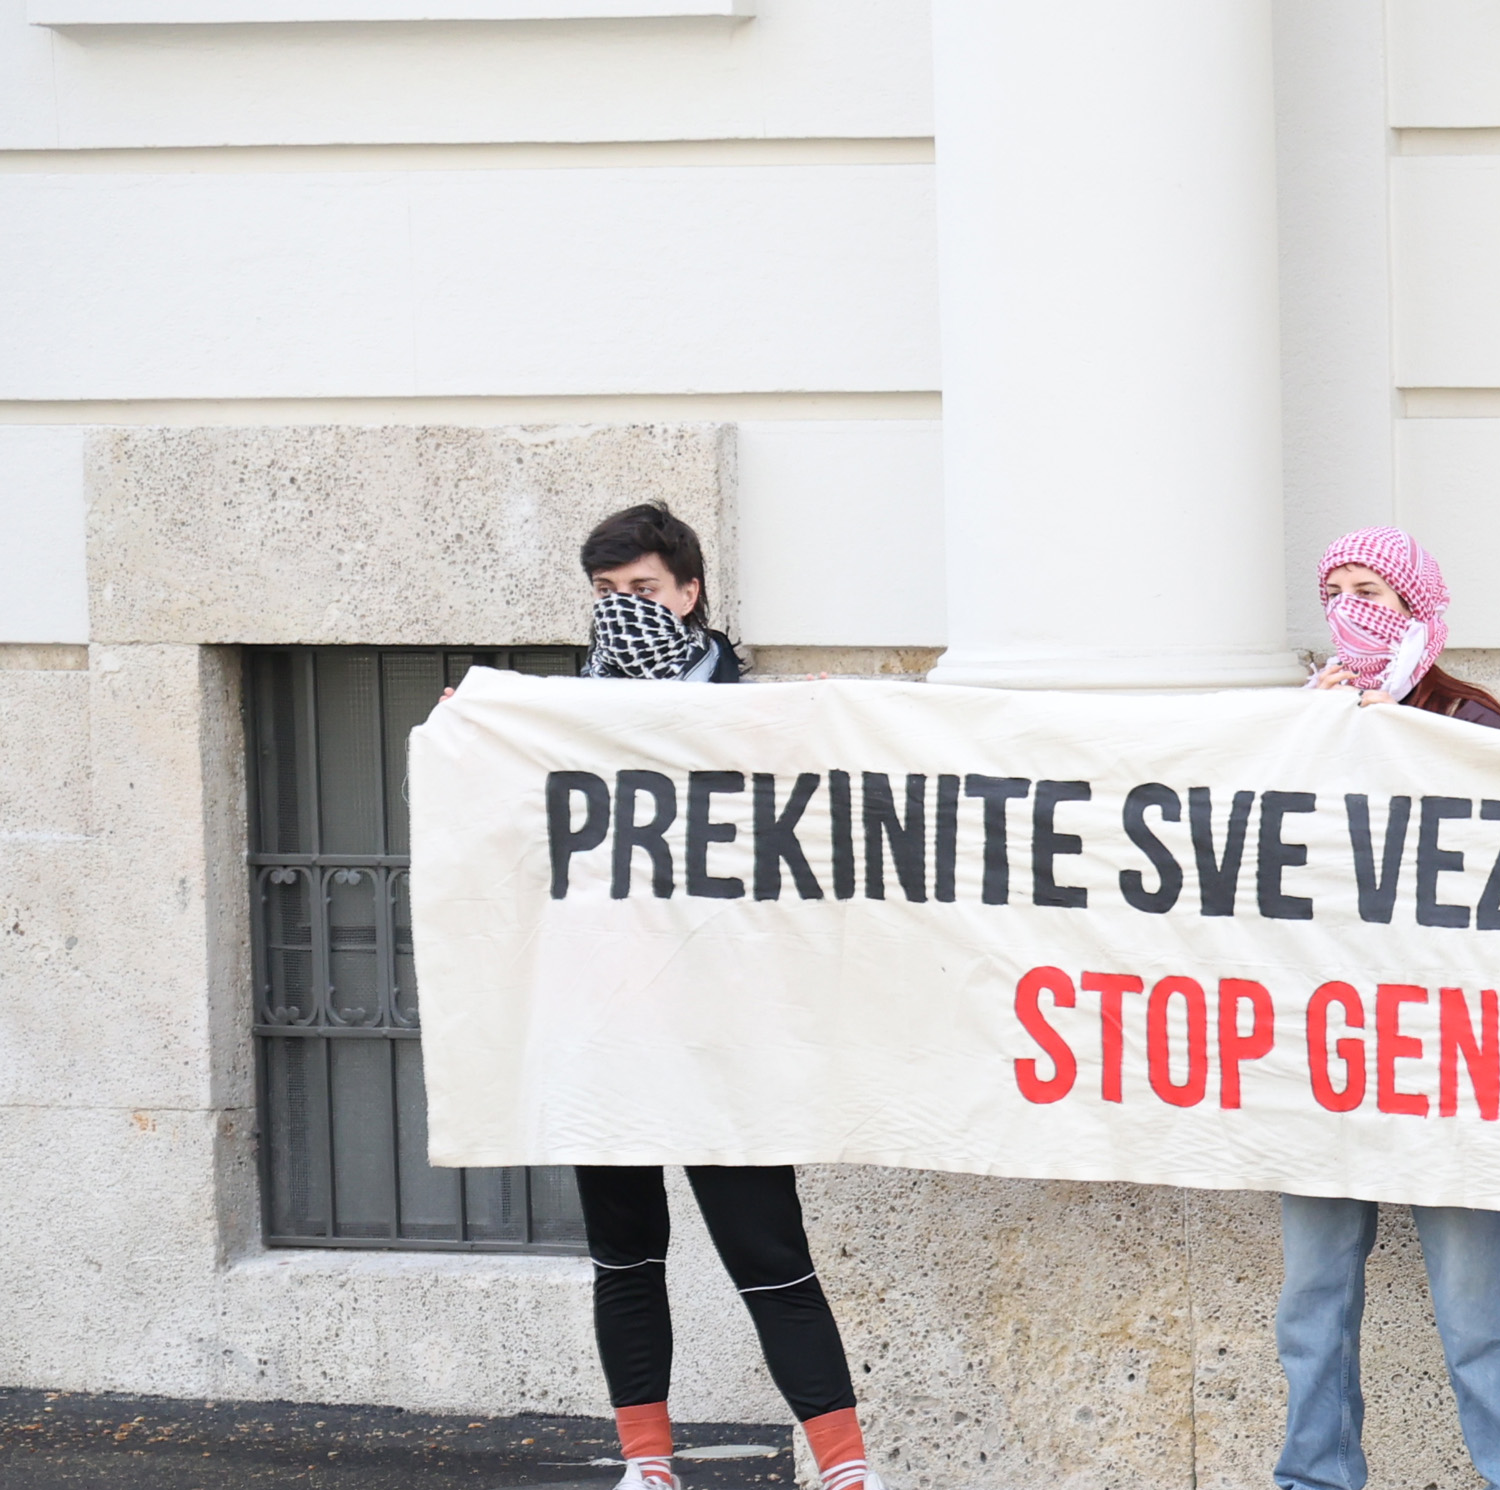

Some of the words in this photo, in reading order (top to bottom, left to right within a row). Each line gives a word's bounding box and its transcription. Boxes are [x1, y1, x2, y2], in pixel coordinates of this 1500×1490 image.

[545, 770, 1092, 914] PREKINITE
[1119, 782, 1317, 920] SVE
[1014, 965, 1275, 1111] STOP
